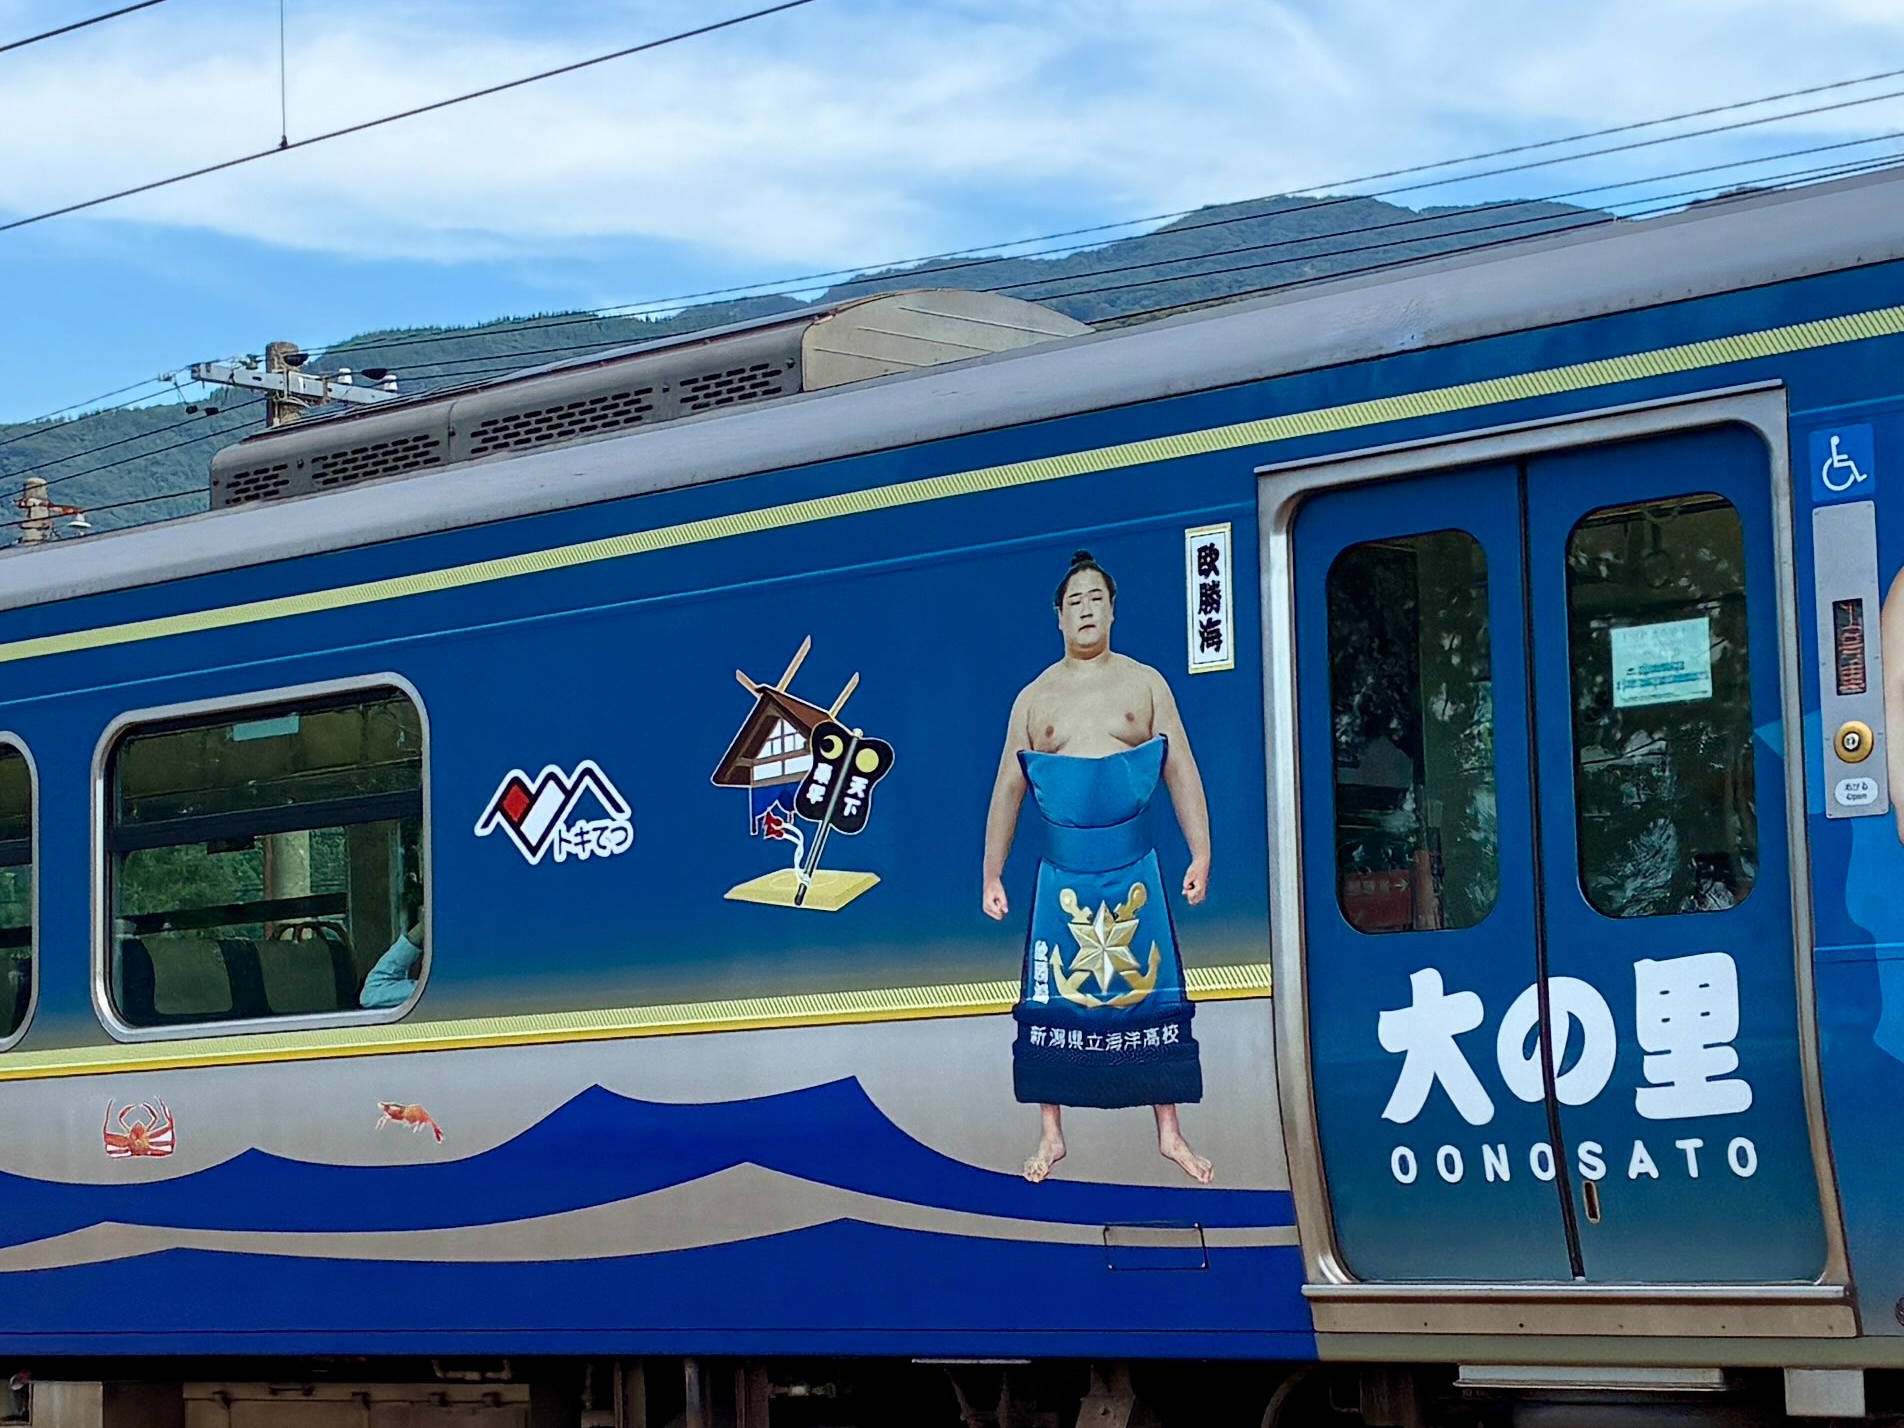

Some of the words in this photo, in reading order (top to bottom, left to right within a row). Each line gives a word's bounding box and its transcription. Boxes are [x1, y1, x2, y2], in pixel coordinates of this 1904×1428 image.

[1197, 542, 1223, 653] 欧勝海
[843, 775, 869, 816] 天下
[557, 822, 631, 856] トキてつ
[1030, 1024, 1180, 1052] 新潟県立海洋高校
[1378, 952, 1753, 1126] 大の里
[1390, 1137, 1758, 1185] OONOSATO
